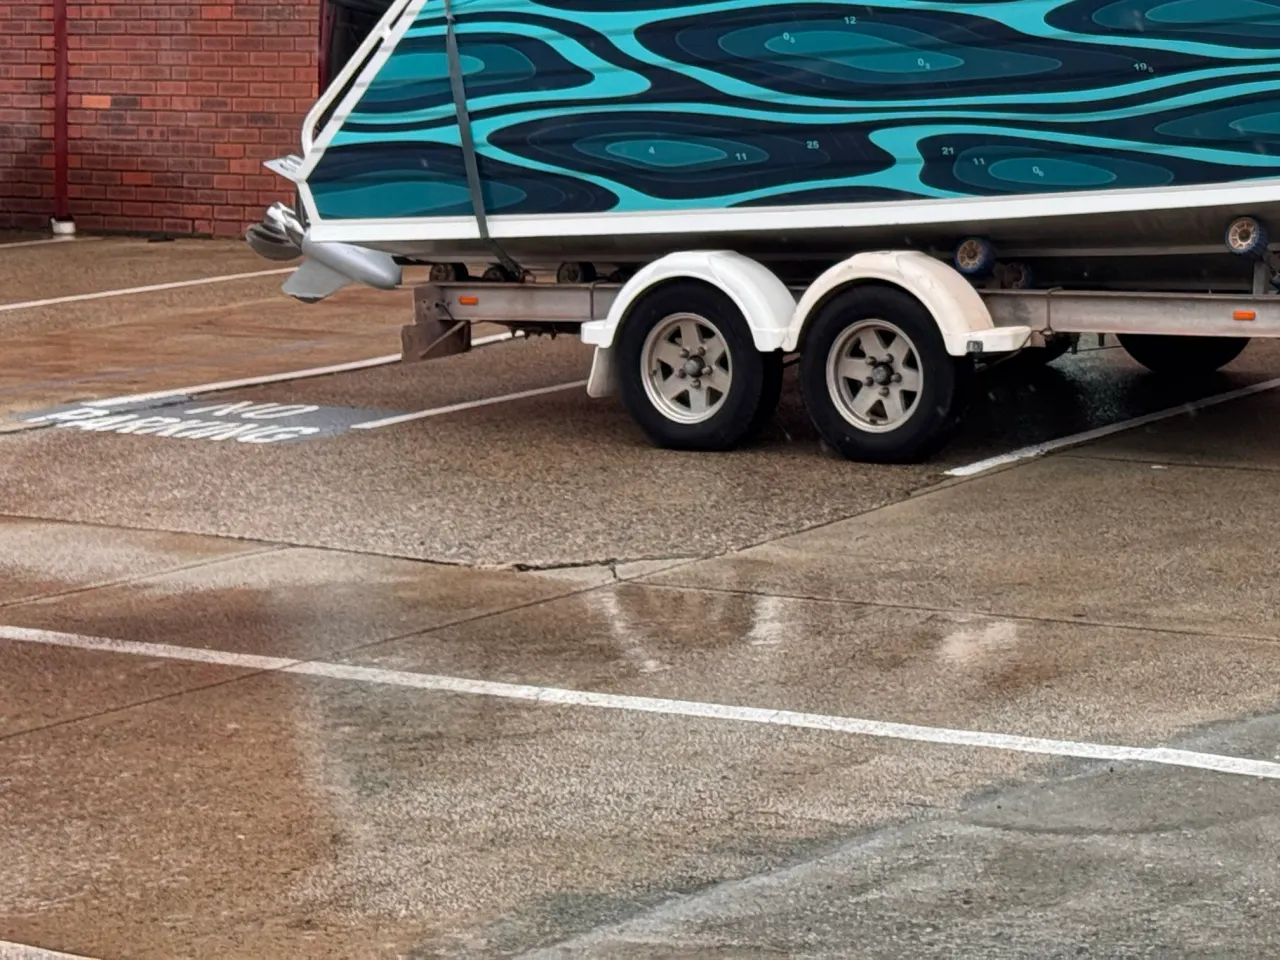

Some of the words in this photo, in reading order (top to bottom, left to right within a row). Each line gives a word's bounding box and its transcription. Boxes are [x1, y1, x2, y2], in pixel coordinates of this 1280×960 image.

[844, 15, 857, 26] 12
[941, 146, 955, 156] 21
[735, 152, 747, 162] 11
[184, 400, 320, 420] NO
[24, 407, 320, 444] PARKING
